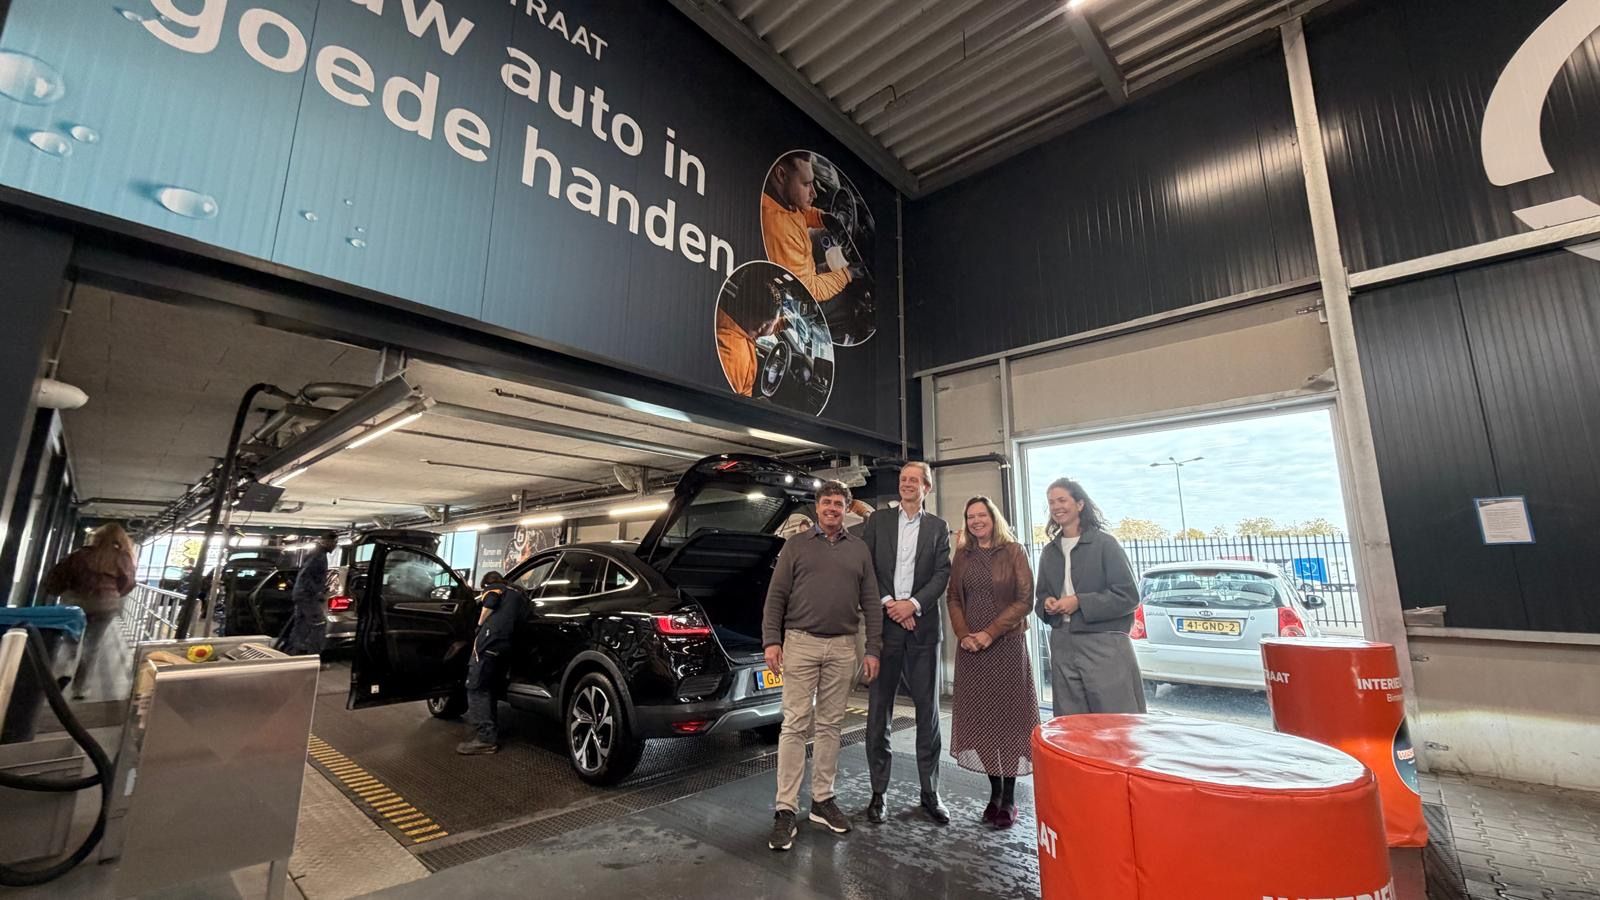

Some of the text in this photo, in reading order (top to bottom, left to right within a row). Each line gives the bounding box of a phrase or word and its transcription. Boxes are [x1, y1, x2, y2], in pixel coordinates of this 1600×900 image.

[510, 0, 608, 61] RAAT
[351, 0, 706, 196] w auto in
[141, 0, 735, 278] goede handen
[1187, 620, 1236, 632] 41-GND-2
[767, 672, 784, 685] GB
[1356, 677, 1402, 690] INTERIE
[1038, 820, 1058, 859] AT
